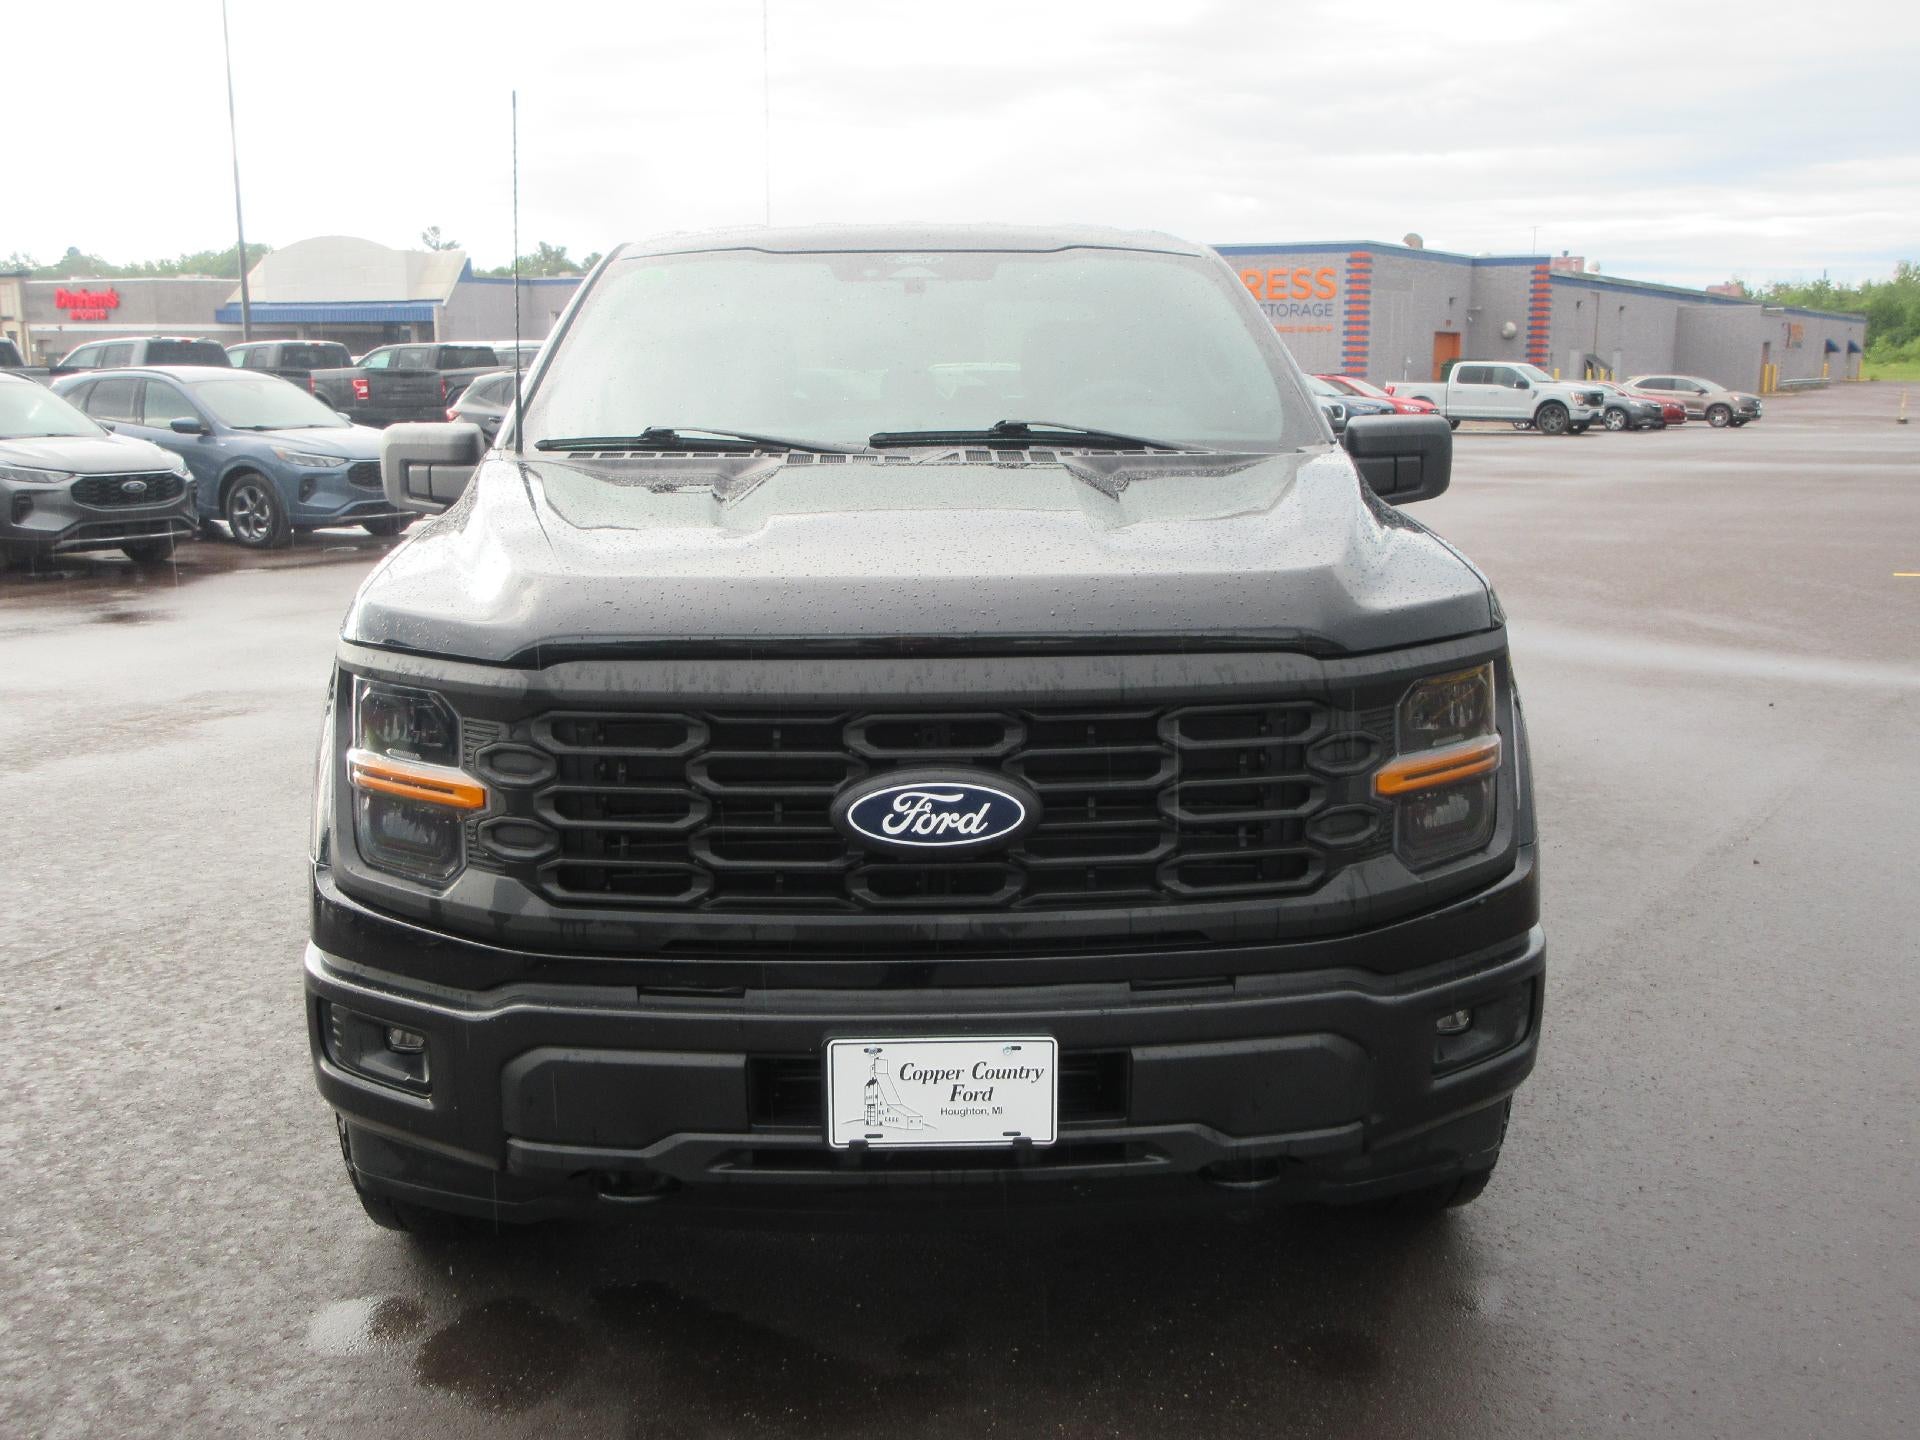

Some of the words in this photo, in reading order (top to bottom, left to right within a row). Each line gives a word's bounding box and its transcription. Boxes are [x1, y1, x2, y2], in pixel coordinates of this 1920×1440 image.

[1240, 268, 1337, 300] RESS
[882, 791, 991, 835] Ford
[899, 1062, 965, 1084] Copper
[972, 1061, 1045, 1083] Country
[949, 1084, 994, 1102] Ford
[940, 1106, 989, 1116] Houghton,
[992, 1106, 1003, 1115] MI
